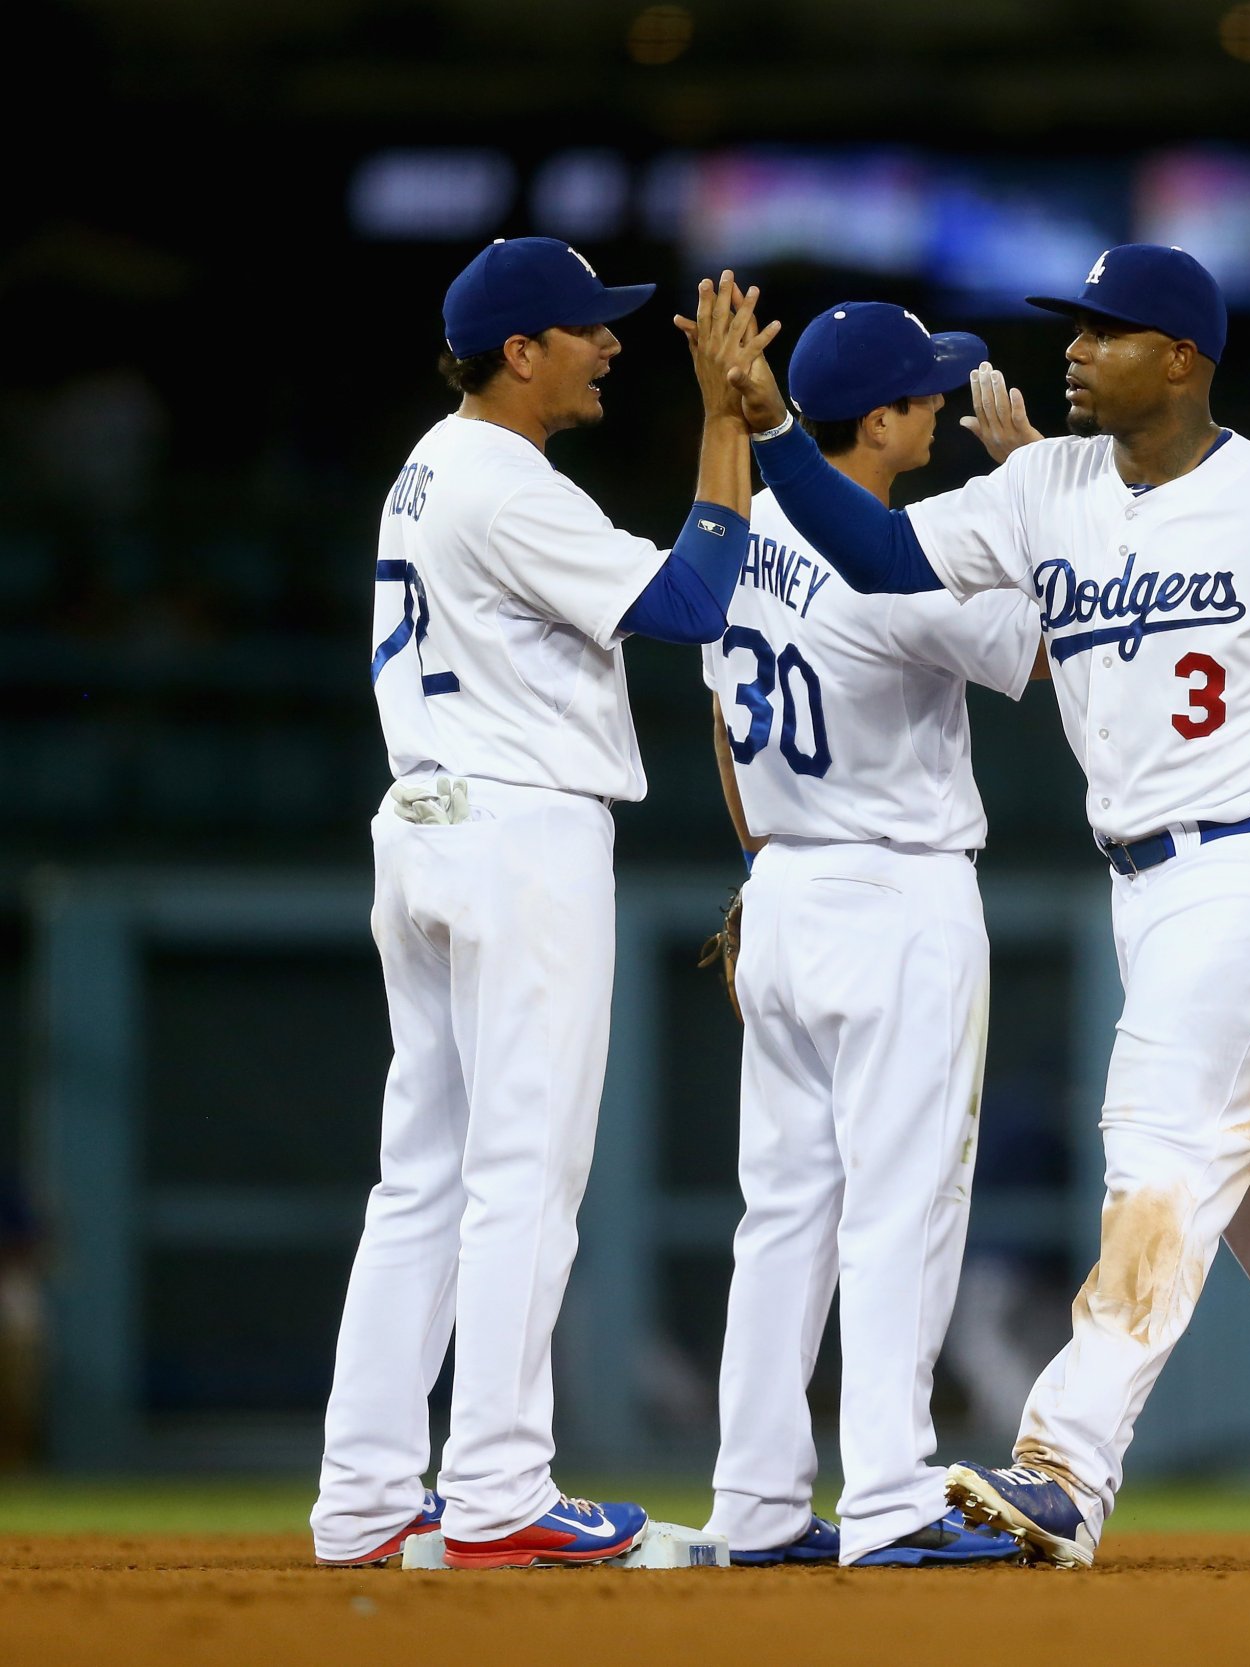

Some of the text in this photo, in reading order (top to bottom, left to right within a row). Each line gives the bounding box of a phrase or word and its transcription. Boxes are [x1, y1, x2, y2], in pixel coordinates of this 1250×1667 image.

[739, 533, 831, 619] ARNEY
[1033, 553, 1247, 667] Dodgers
[722, 624, 833, 779] 30
[1172, 651, 1227, 740] 3
